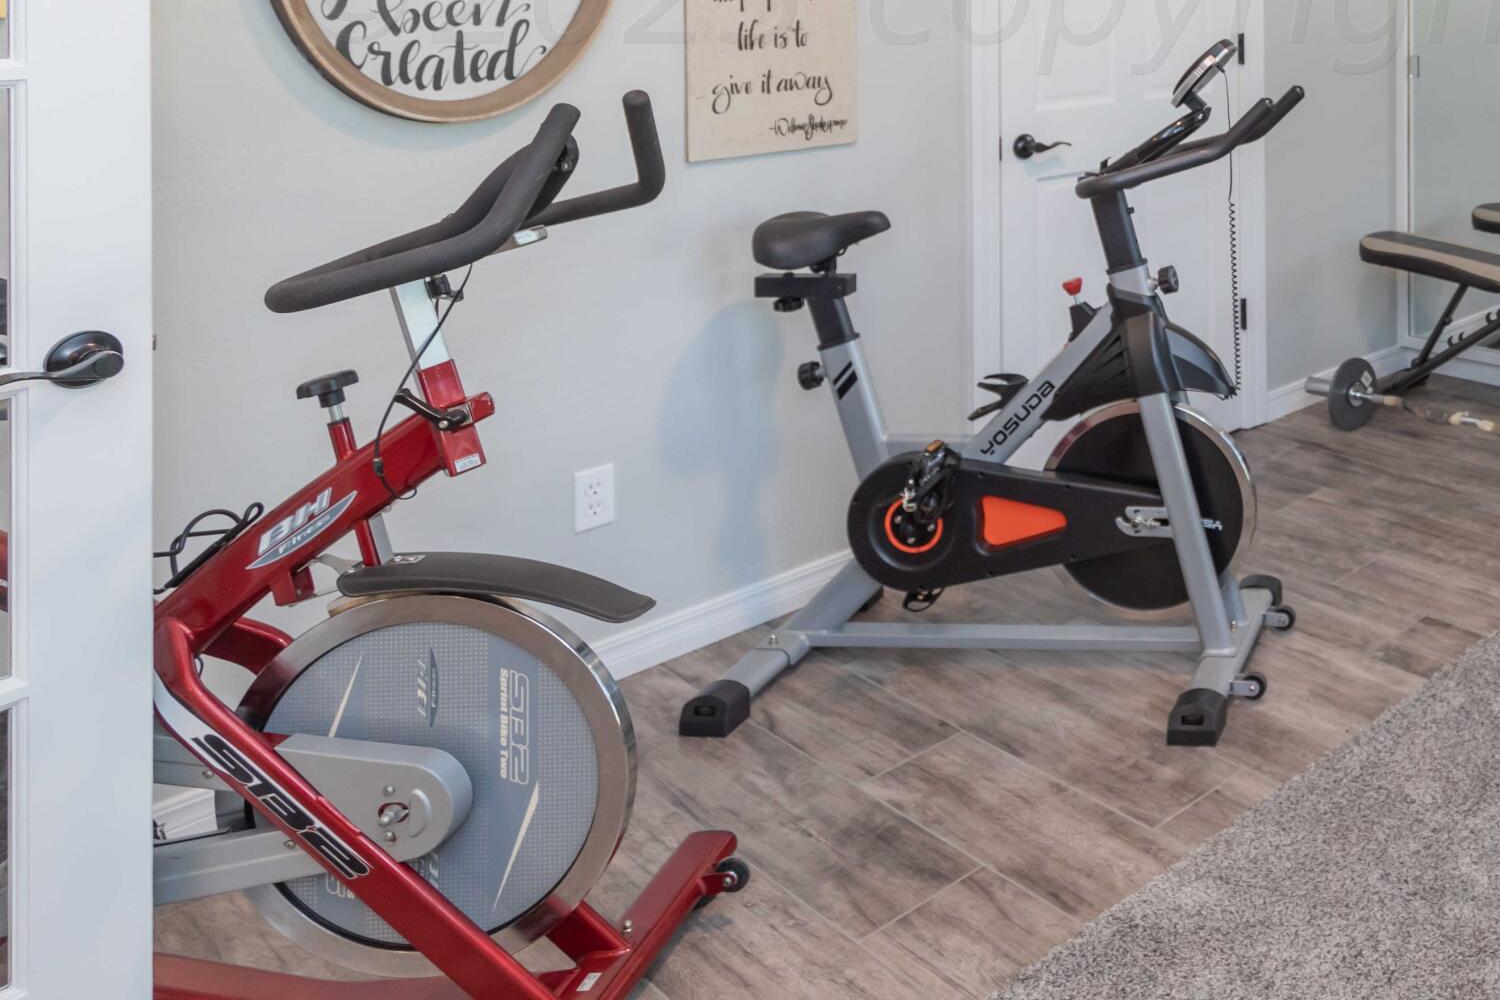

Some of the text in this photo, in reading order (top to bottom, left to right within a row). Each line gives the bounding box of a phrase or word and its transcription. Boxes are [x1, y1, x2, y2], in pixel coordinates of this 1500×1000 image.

[737, 19, 809, 51] life is to
[711, 69, 834, 115] give it away
[980, 380, 1056, 456] YOSUDA
[499, 714, 509, 747] Bike
[499, 749, 509, 779] Two
